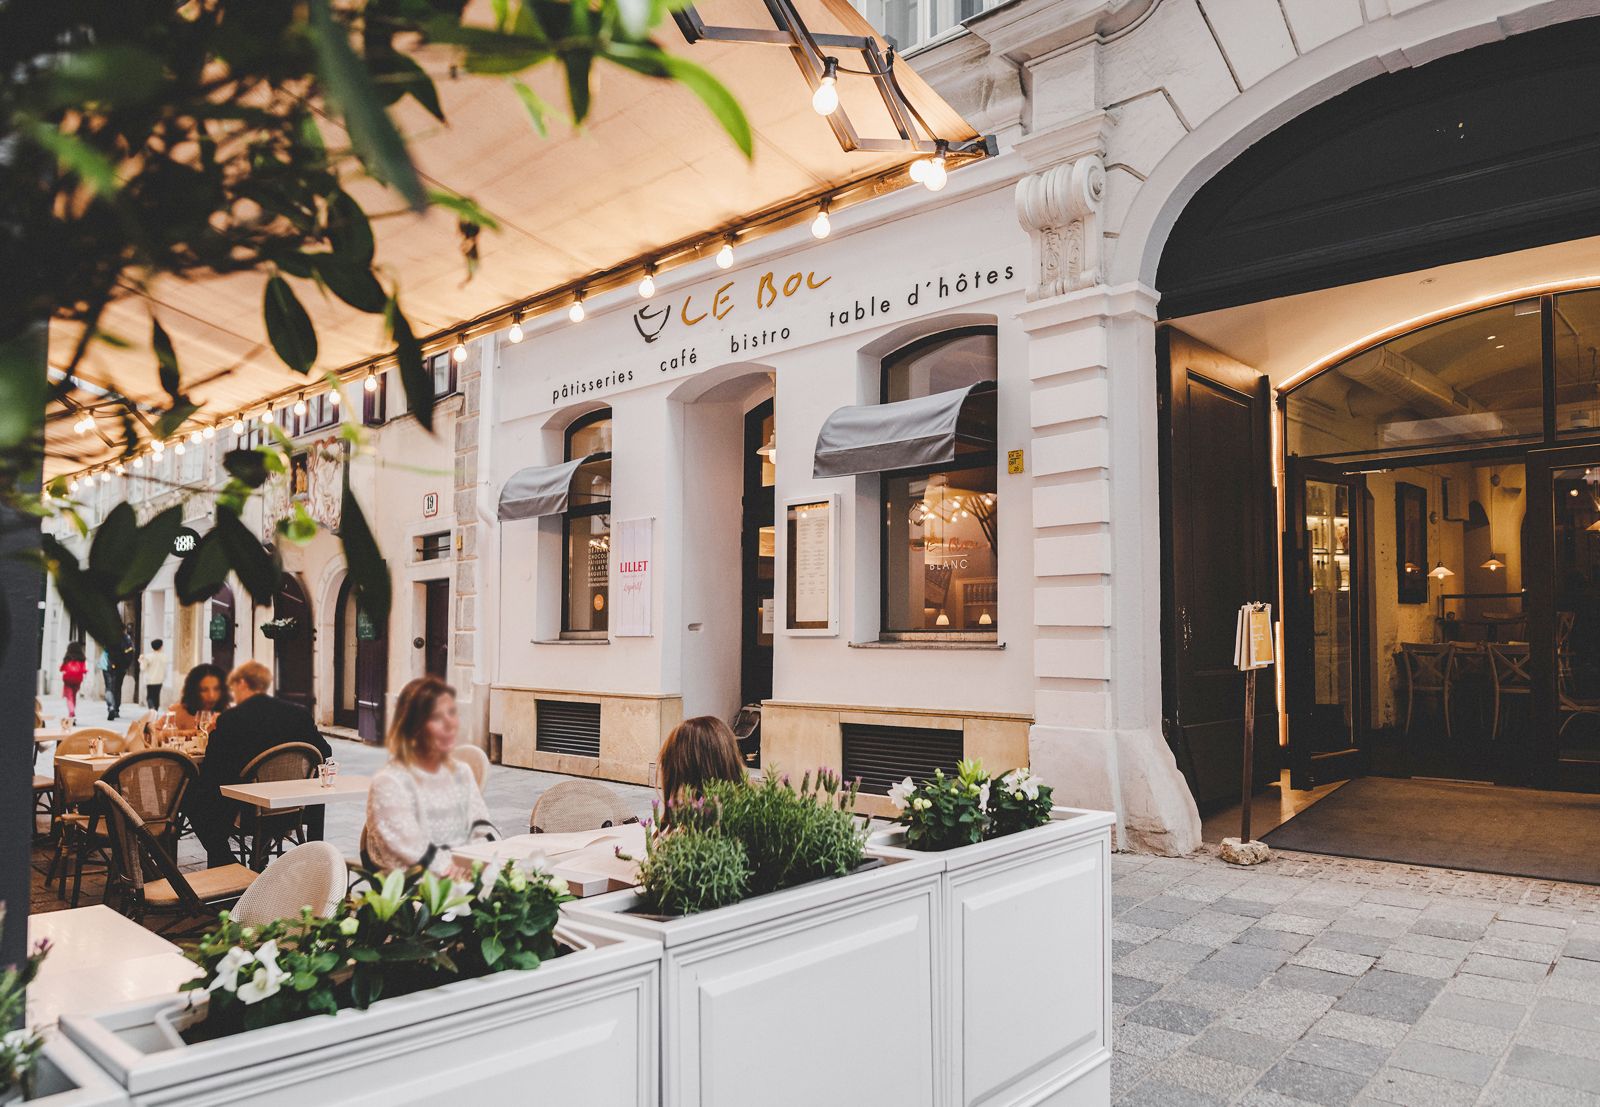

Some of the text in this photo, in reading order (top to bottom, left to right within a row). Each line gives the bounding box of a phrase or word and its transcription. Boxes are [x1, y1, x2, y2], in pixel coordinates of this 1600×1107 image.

[681, 281, 735, 326] LE
[552, 370, 635, 405] pâtisseries
[660, 346, 699, 372] café
[730, 327, 792, 355] bistro
[829, 295, 891, 328] table
[427, 495, 434, 510] 19
[620, 560, 648, 573] LILLET
[929, 559, 968, 572] BLANC
